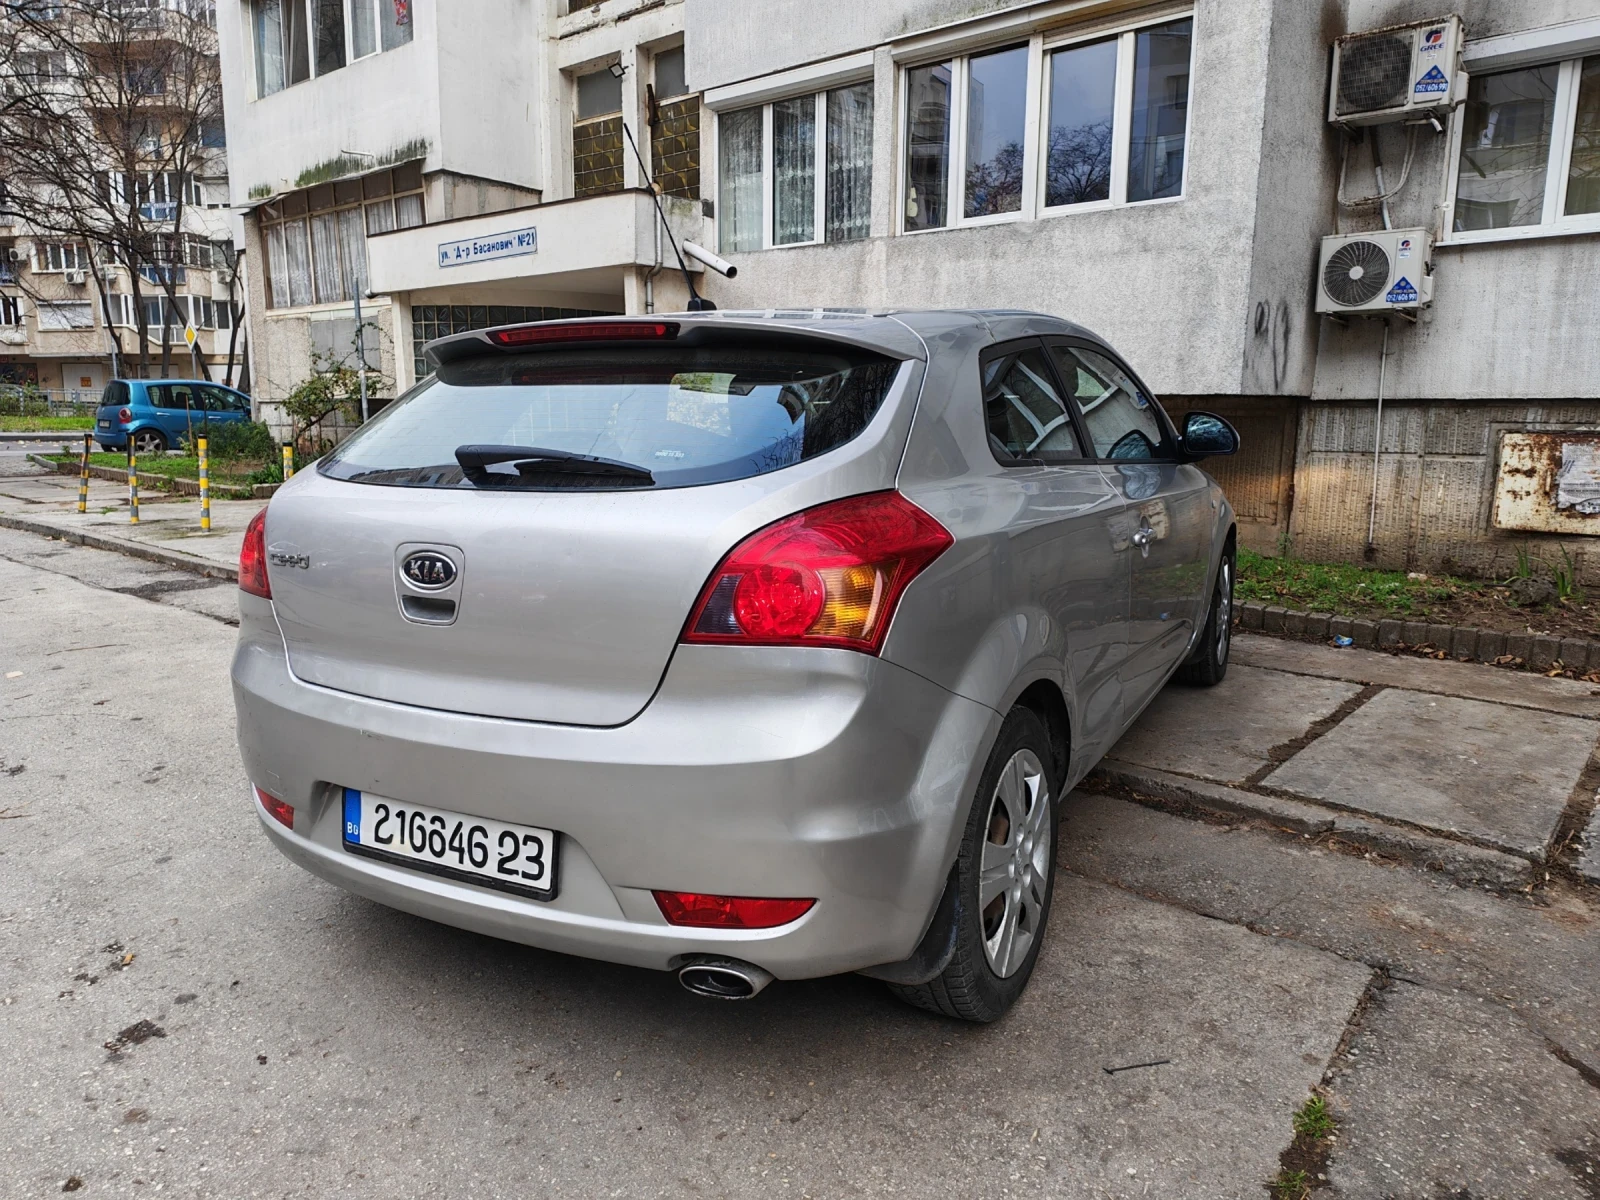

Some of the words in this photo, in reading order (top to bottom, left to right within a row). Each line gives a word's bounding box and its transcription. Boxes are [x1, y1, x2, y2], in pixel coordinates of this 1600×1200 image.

[1420, 42, 1446, 52] GREE
[440, 250, 451, 263] ул.
[408, 559, 447, 582] KIA
[346, 821, 359, 835] BG
[374, 803, 489, 869] 216646
[497, 830, 545, 882] 23
